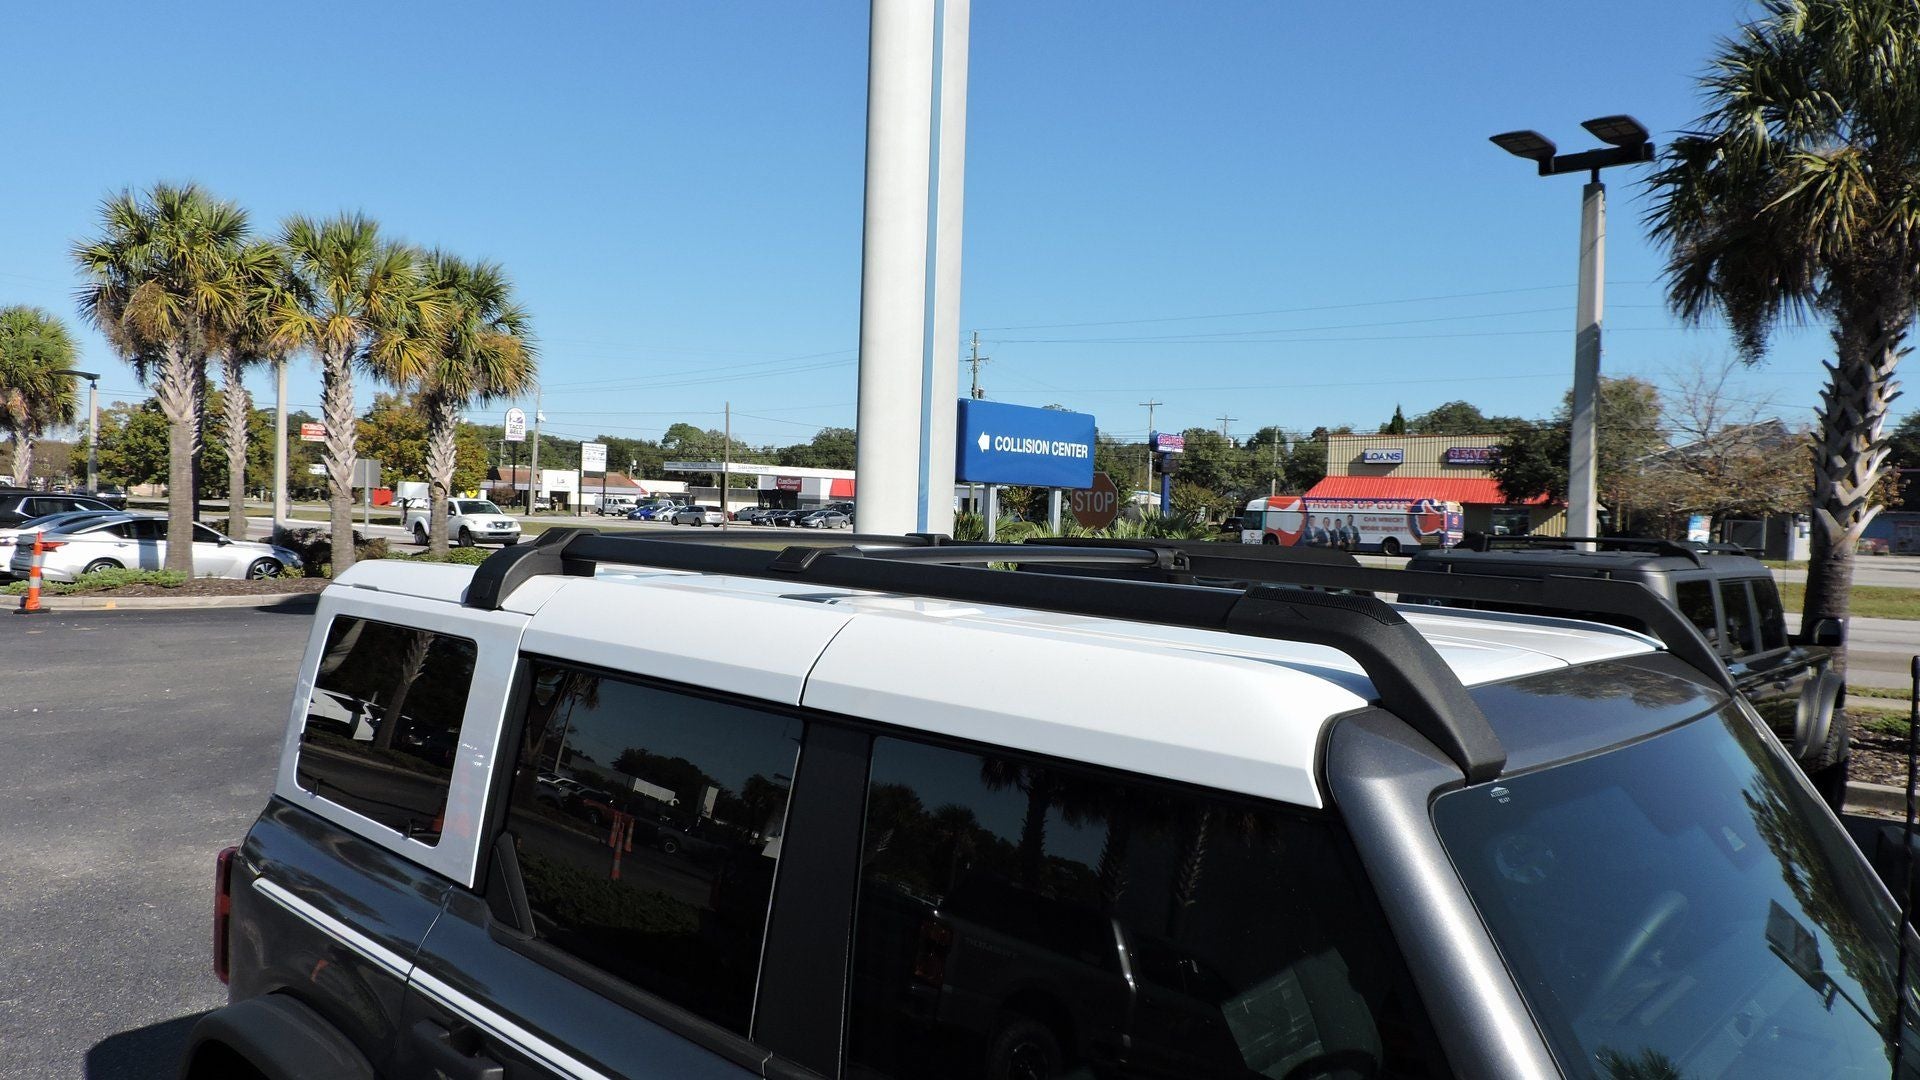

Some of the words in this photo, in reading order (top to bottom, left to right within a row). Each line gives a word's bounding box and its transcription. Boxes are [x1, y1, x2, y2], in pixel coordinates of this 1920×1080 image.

[994, 435, 1050, 456] COLLISION
[1051, 441, 1089, 459] CENTER
[1364, 452, 1401, 460] LOANS
[1074, 491, 1115, 513] STOP
[1306, 499, 1355, 509] THUMBS
[1357, 500, 1374, 509] UP
[1376, 500, 1411, 510] GUYS
